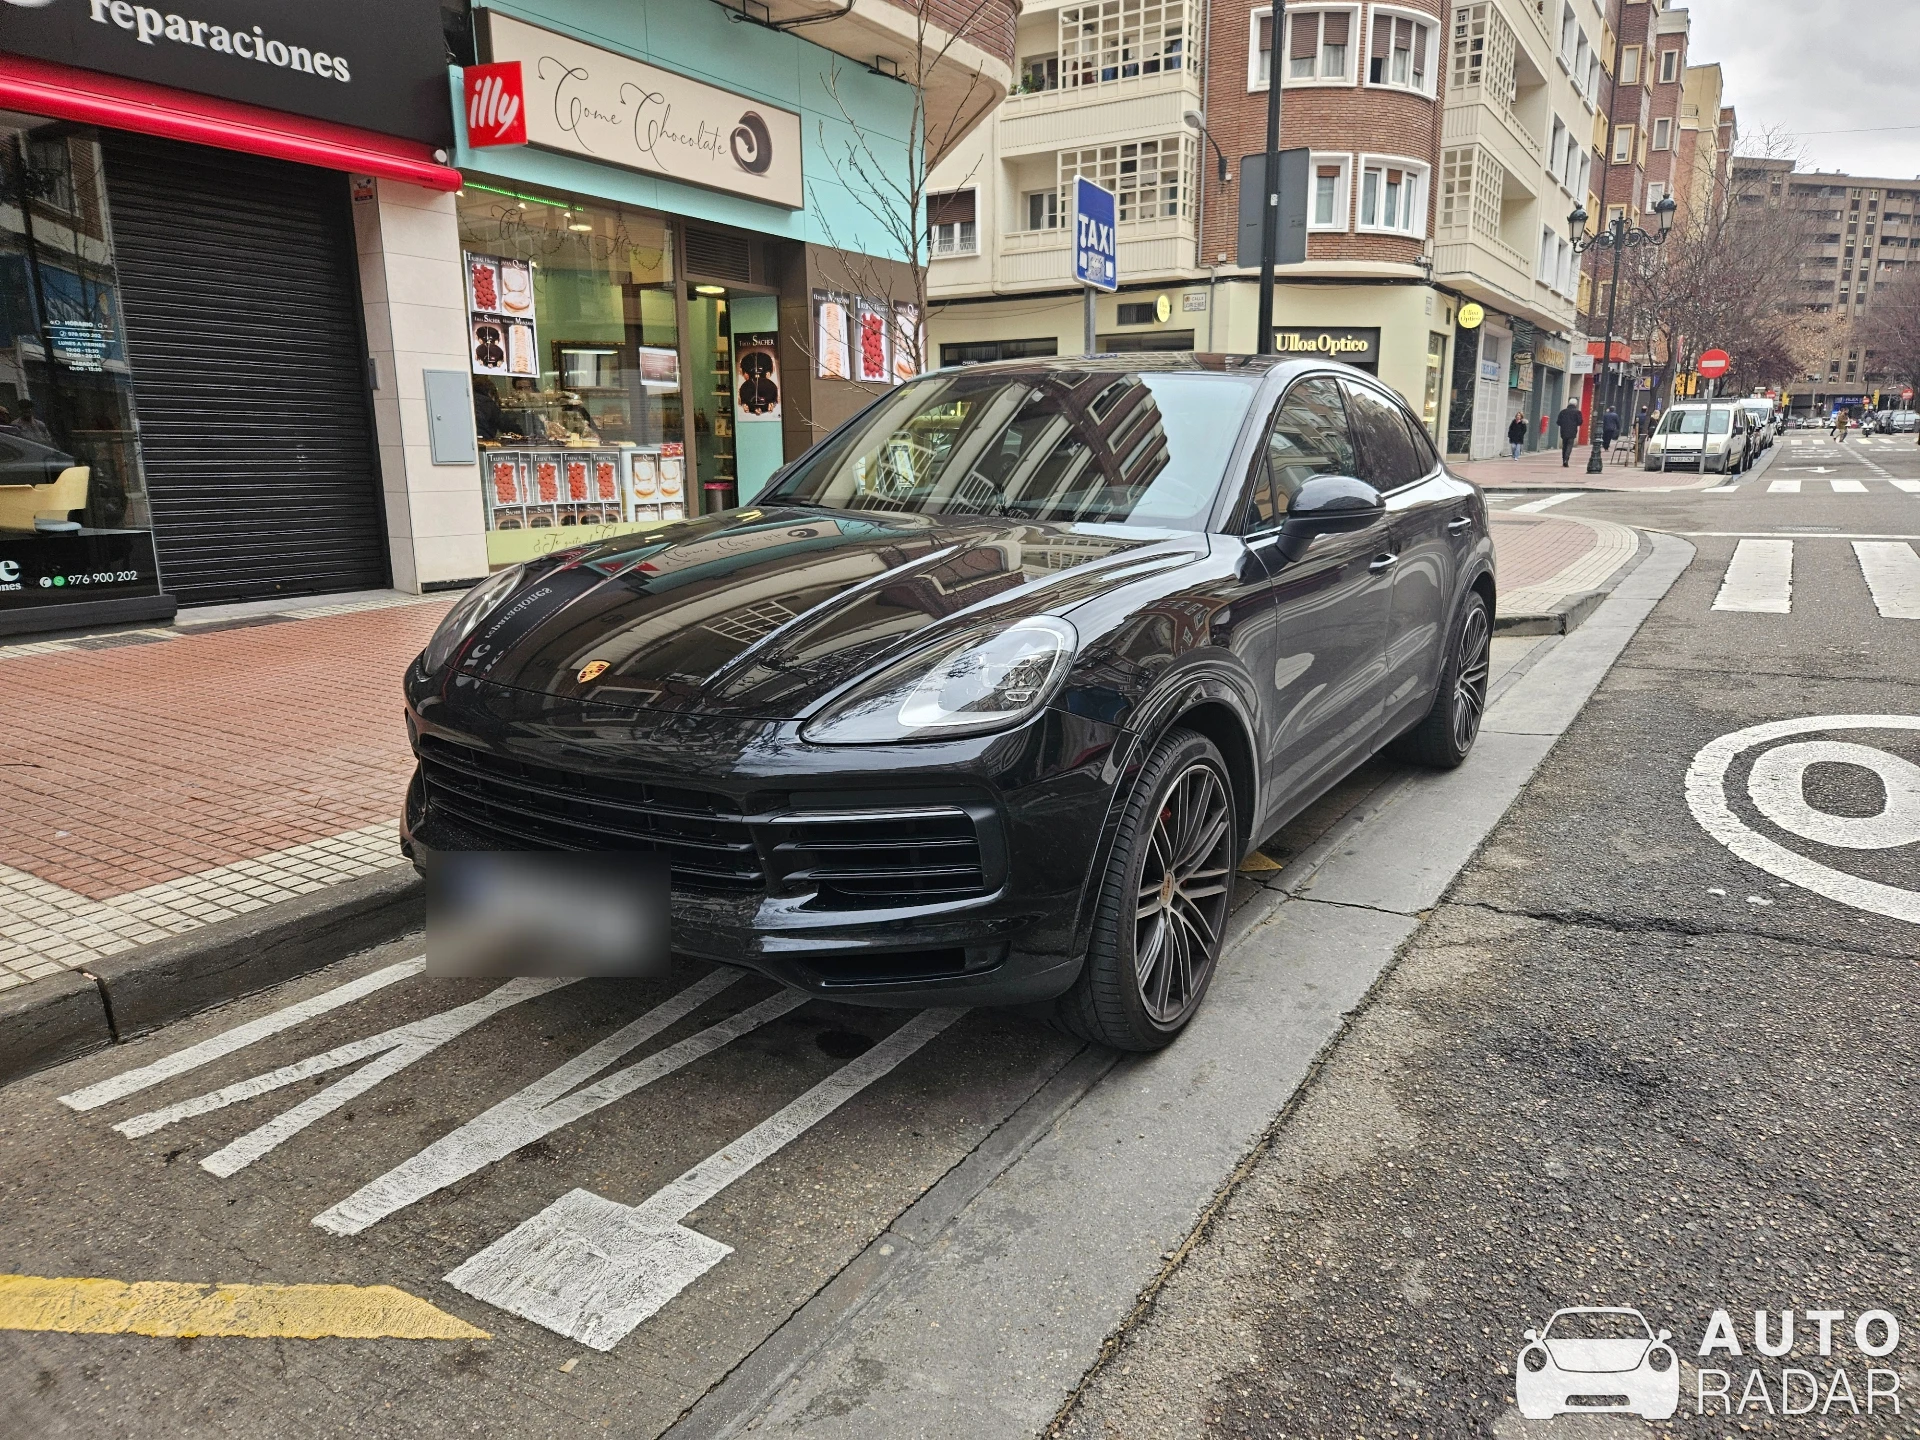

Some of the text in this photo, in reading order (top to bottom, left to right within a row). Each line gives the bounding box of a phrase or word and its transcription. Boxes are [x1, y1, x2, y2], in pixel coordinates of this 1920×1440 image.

[90, 0, 351, 83] reparaciones
[469, 75, 519, 138] illy
[538, 56, 727, 171] Come Chocolate
[1078, 213, 1114, 256] TAXI
[752, 335, 775, 347] SACHER
[1275, 333, 1369, 356] Ulloa Optico
[0, 583, 22, 592] nes
[67, 570, 138, 585] 976 900 202
